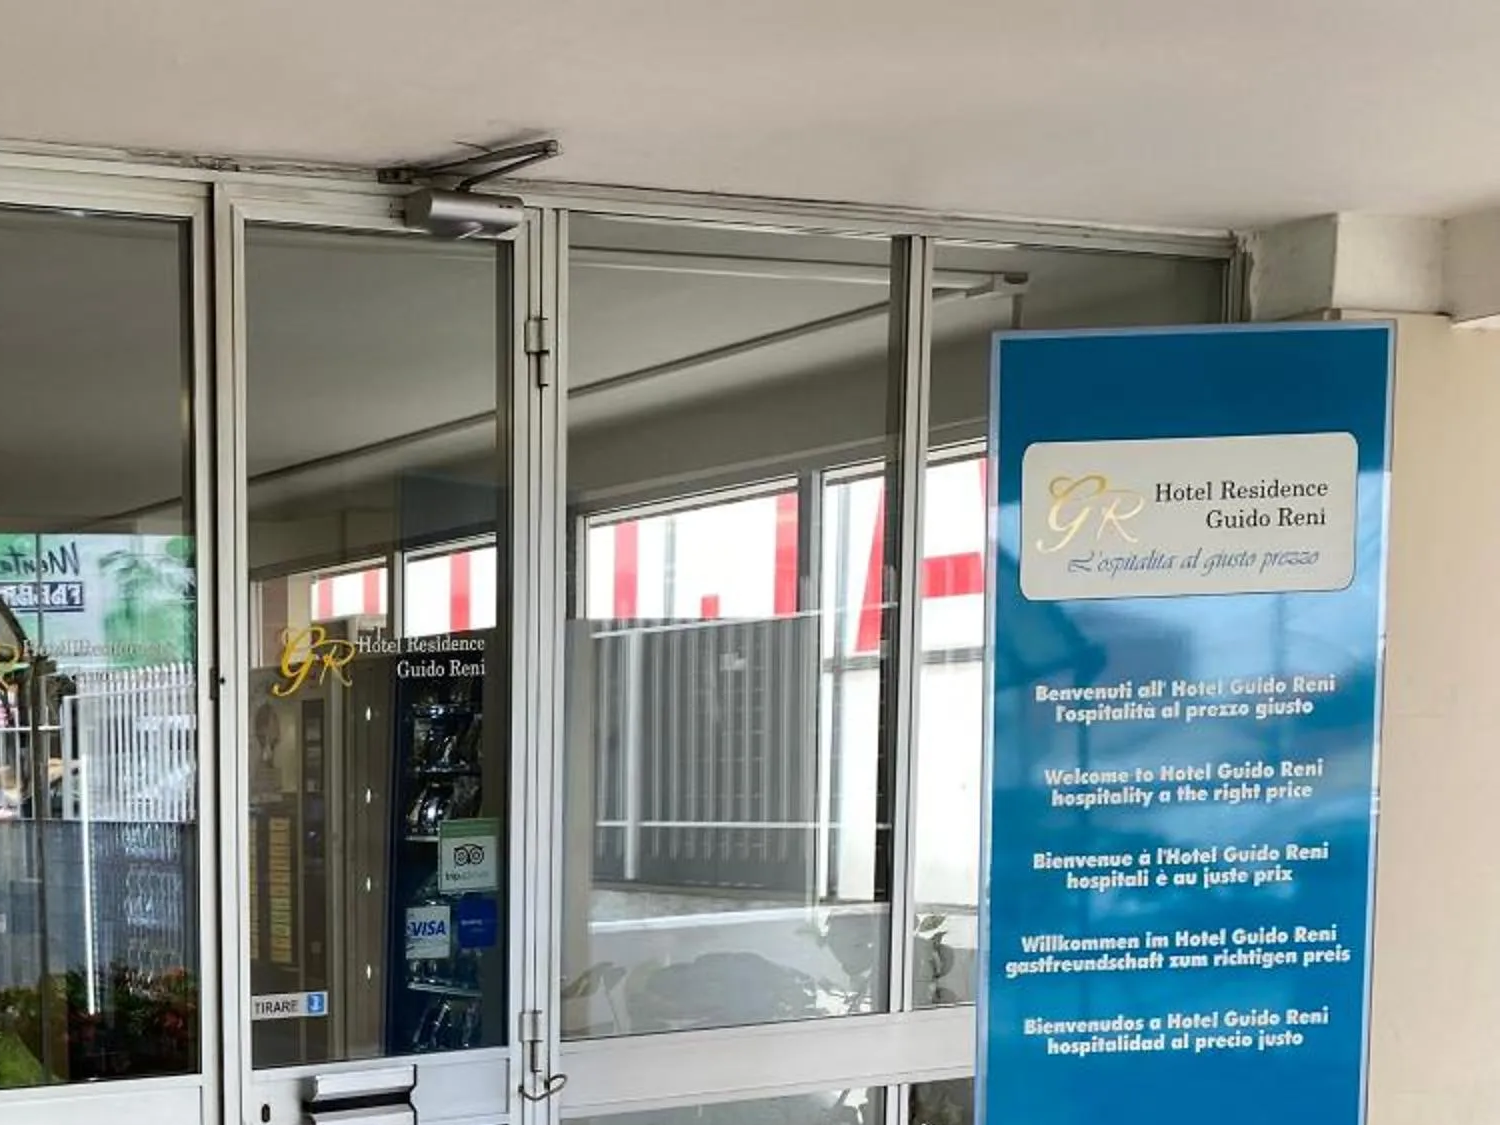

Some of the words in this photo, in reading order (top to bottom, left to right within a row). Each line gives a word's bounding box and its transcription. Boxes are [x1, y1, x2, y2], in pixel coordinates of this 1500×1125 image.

[1155, 481, 1212, 503] Hotel
[1220, 479, 1329, 501] Residence
[1206, 509, 1271, 530] Guido
[1277, 507, 1326, 527] Reni
[1179, 548, 1202, 571] al
[359, 635, 401, 654] Hotel
[407, 636, 485, 653] Residence
[397, 660, 445, 678] Guido
[449, 659, 486, 676] Reni
[1035, 680, 1133, 702] Benvenuti
[1171, 679, 1224, 698] Hotel
[1230, 677, 1287, 695] Guido
[1293, 674, 1336, 693] Reni
[1161, 702, 1180, 720] al
[1186, 702, 1249, 723] prezzo
[1255, 698, 1314, 720] giusto
[1044, 767, 1129, 786] Welcome
[1135, 767, 1153, 782] to
[1160, 763, 1211, 782] Hotel
[1218, 761, 1274, 780] Guido
[1280, 758, 1323, 777] Reni
[1051, 787, 1153, 810] hospitality
[1159, 790, 1171, 803] a
[1177, 784, 1208, 802] the
[1213, 781, 1261, 803] right
[1266, 781, 1313, 803] price
[1033, 850, 1133, 870] Bienvenue
[1156, 846, 1218, 865] l'Hotel
[1223, 844, 1280, 863] Guido
[1286, 841, 1329, 861] Reni
[1066, 870, 1149, 894] hospitali
[1173, 870, 1197, 887] au
[1203, 866, 1249, 889] juste
[1254, 865, 1293, 887] prix
[411, 920, 446, 937] VISA
[1021, 933, 1140, 953] Willkommen
[1145, 931, 1169, 949] im
[1175, 929, 1226, 947] Hotel
[1232, 926, 1288, 945] Guido
[1294, 924, 1337, 943] Reni
[1005, 952, 1164, 979] gastfreundschaft
[1169, 953, 1208, 968] zum
[1213, 947, 1297, 969] richtigen
[1303, 944, 1351, 968] preis
[255, 999, 298, 1014] TIRARE
[1149, 1018, 1162, 1031] a
[1167, 1011, 1219, 1029] Hotel
[1224, 1009, 1280, 1027] Guido
[1286, 1006, 1329, 1025] Reni
[1047, 1034, 1165, 1058] hospitalidad
[1171, 1033, 1189, 1051] al
[1195, 1033, 1253, 1053] precio
[1258, 1030, 1304, 1051] justo
